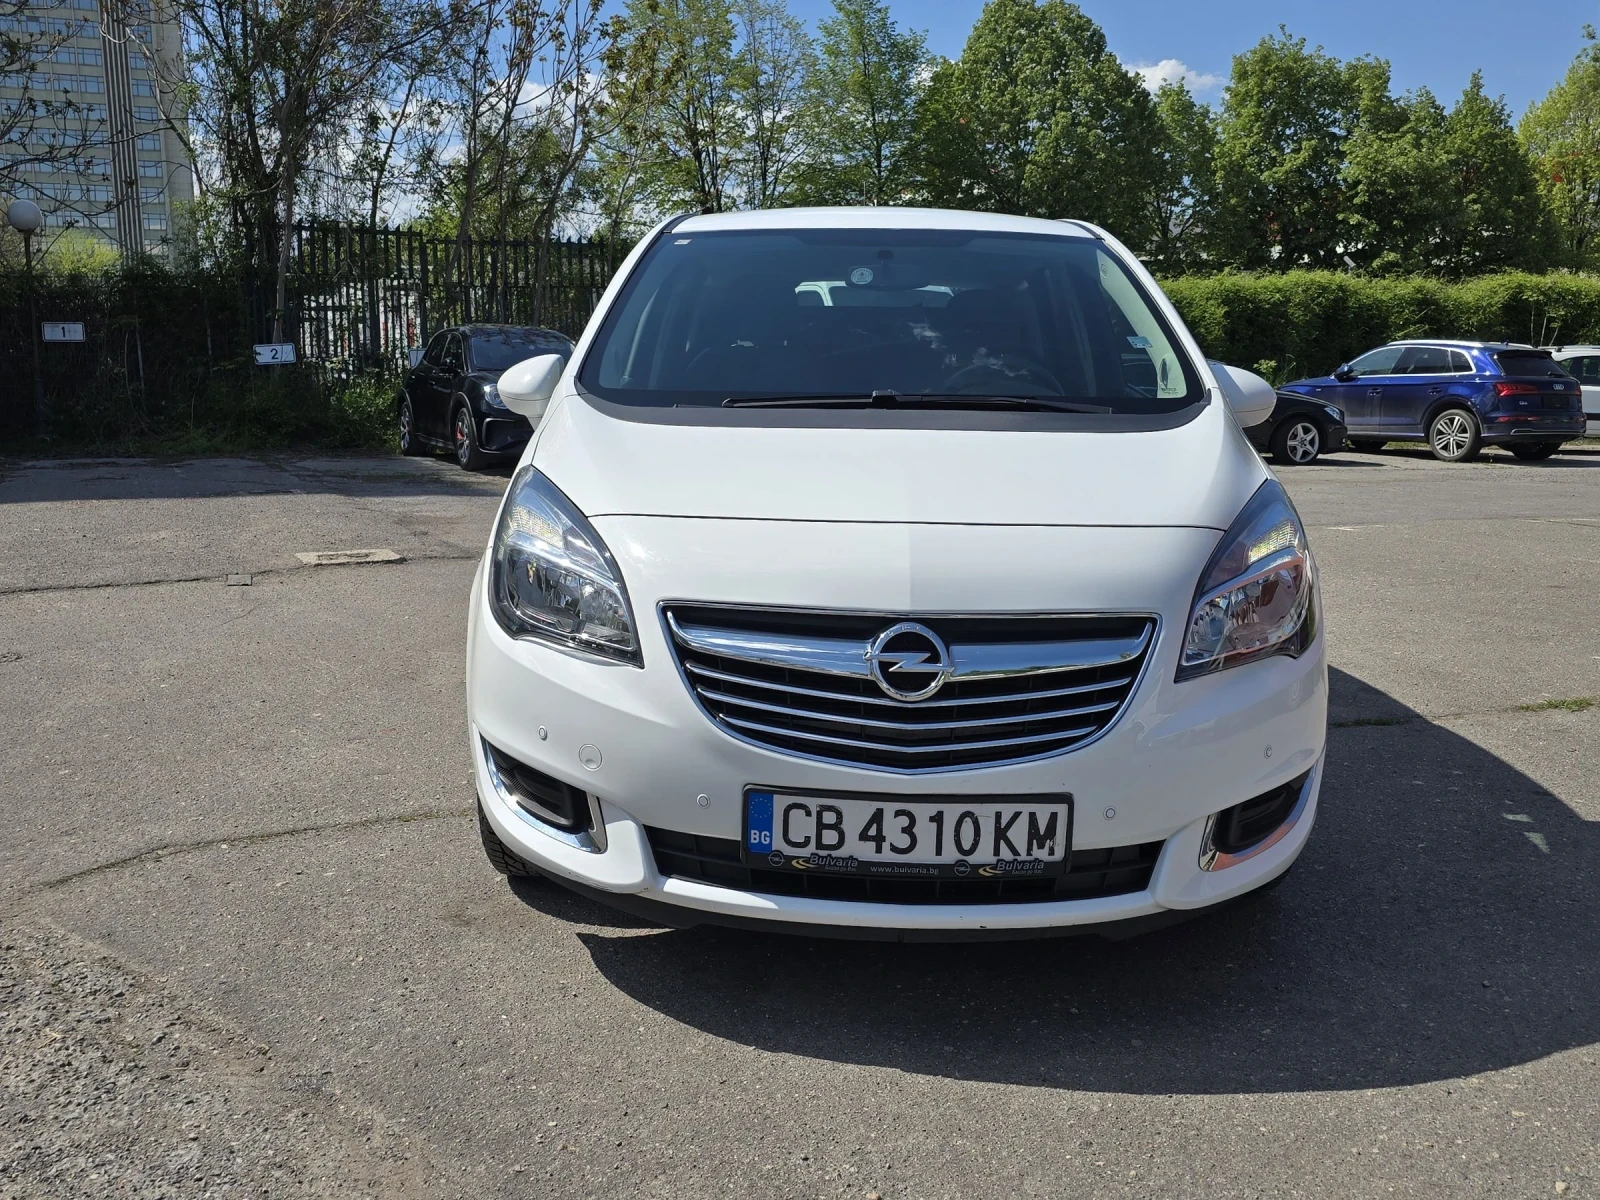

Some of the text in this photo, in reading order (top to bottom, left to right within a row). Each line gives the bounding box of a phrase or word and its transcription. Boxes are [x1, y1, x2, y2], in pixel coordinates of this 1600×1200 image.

[61, 326, 66, 338] 1
[270, 348, 279, 360] 2
[782, 802, 1059, 857] CB 4310 KM
[750, 829, 771, 844] BG
[809, 854, 858, 868] Bulvaria
[996, 859, 1045, 871] Bulvaria
[870, 865, 940, 876] www.bulvaria.bg
